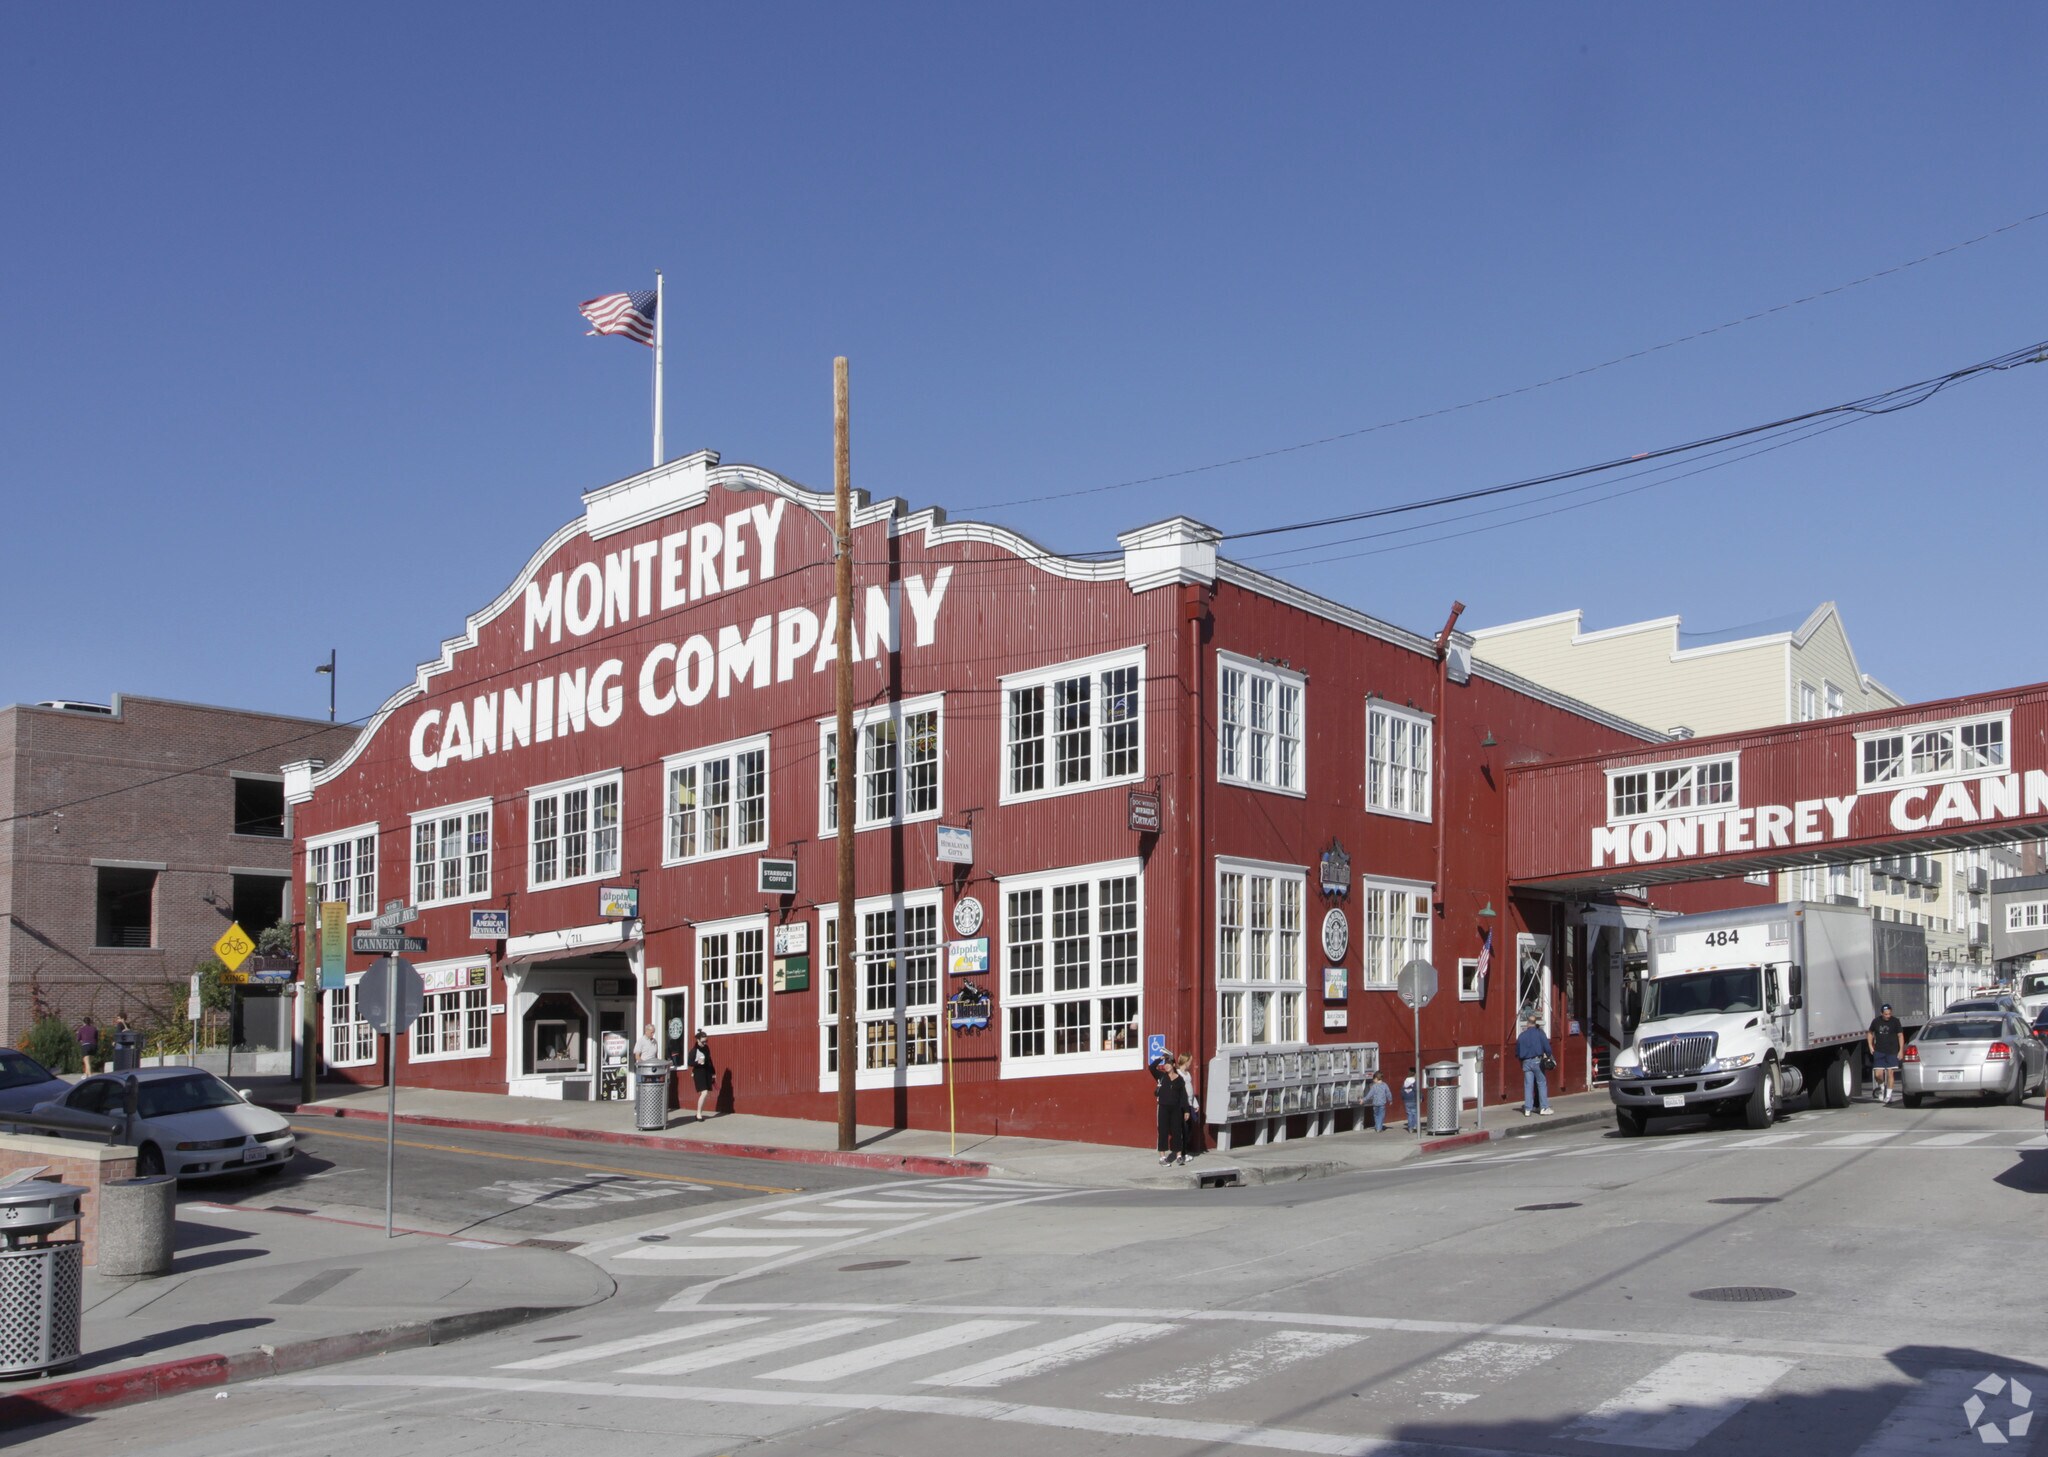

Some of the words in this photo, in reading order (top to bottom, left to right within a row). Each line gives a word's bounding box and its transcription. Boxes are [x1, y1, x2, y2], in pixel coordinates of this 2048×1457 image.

[523, 498, 786, 652] MONTEREY
[409, 659, 623, 772] CANNING
[638, 566, 954, 717] COMPANY
[1591, 795, 1858, 868] MONTEREY
[763, 869, 793, 878] STARBUCKS
[768, 875, 788, 883] COFFEE
[475, 919, 504, 927] AMERICAN
[571, 933, 582, 944] 711
[1705, 929, 1739, 947] 484
[357, 938, 400, 950] CANNERY
[404, 938, 423, 950] ROW
[224, 974, 245, 982] XING
